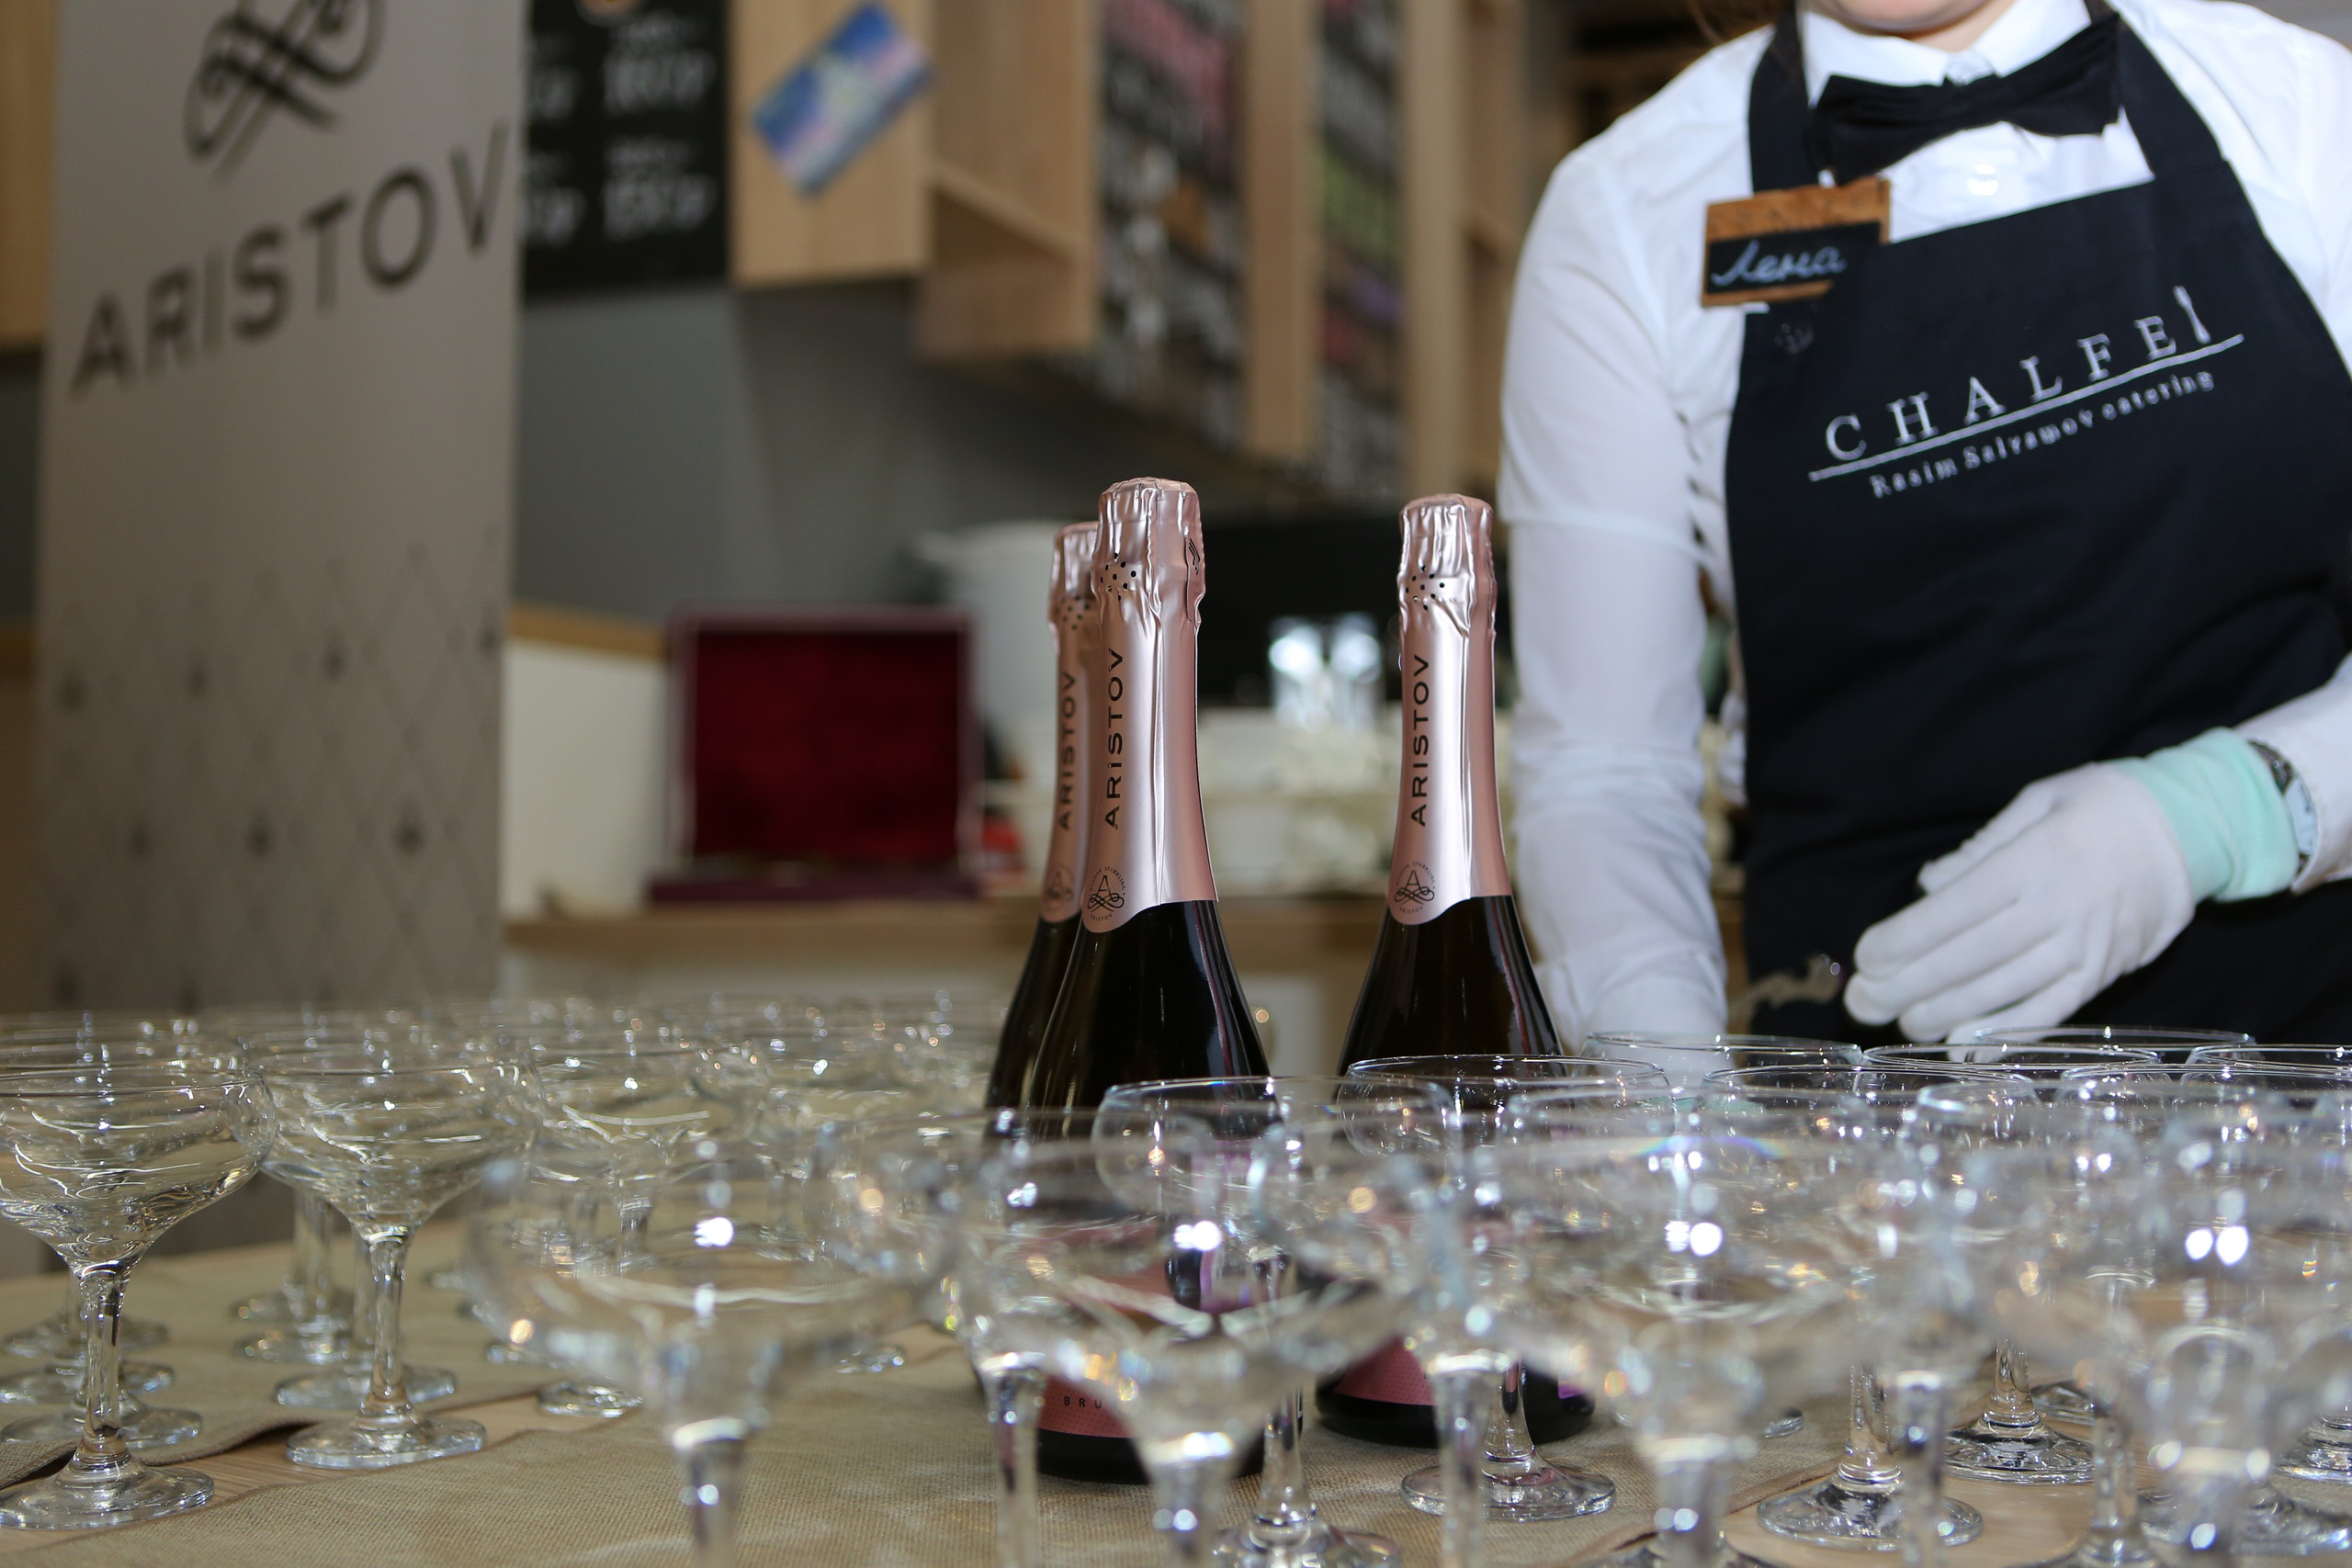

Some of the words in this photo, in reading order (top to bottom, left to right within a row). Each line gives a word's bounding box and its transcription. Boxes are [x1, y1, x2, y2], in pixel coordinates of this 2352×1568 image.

[70, 118, 511, 397] ARISTOV
[1057, 671, 1077, 831] ARISTOV
[1104, 648, 1124, 830] ARISTOV
[1410, 654, 1430, 827] ARISTOV
[1104, 866, 1126, 891] SPARKLING
[1063, 1395, 1102, 1410] BRU
